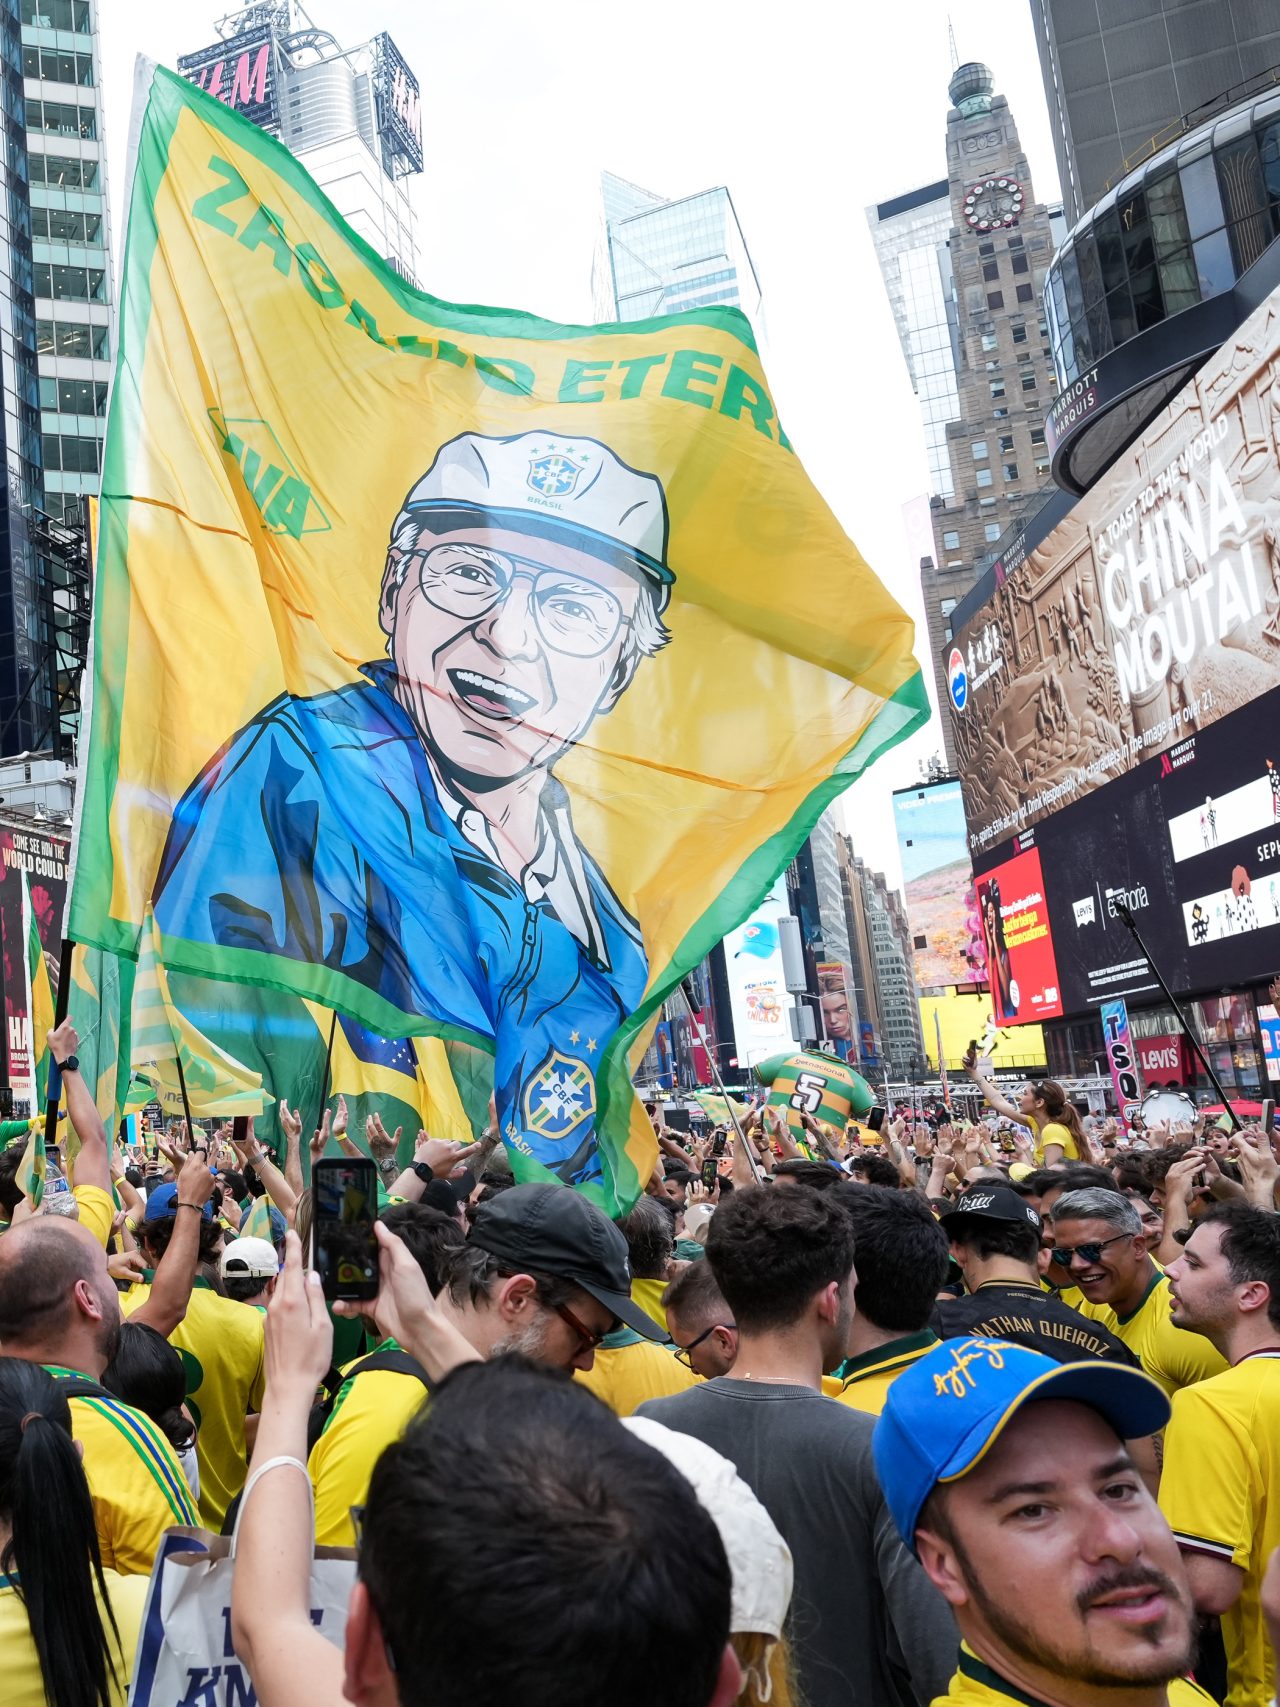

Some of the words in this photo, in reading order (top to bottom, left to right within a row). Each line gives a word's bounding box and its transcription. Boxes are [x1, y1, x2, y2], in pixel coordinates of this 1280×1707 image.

[557, 350, 794, 454] ETER
[1052, 368, 1099, 422] MARRIOTT
[1055, 392, 1095, 439] MARQUIS
[527, 496, 564, 511] BRASIL
[1099, 533, 1107, 552] A
[1107, 500, 1137, 544] TOAST
[1139, 486, 1155, 512] TO
[1156, 460, 1180, 498] THE
[1179, 414, 1228, 474] WORLD
[1003, 534, 1026, 563] MARRIOTT
[1005, 549, 1025, 575] MARQUIS
[1104, 457, 1247, 629] CHINA
[1114, 540, 1264, 704] MOUTAI
[1027, 793, 1042, 814] Drink
[1087, 749, 1120, 776] characters
[1129, 735, 1143, 755] the
[1143, 721, 1168, 747] image
[1168, 713, 1181, 731] are
[1182, 704, 1201, 723] over
[1170, 738, 1196, 758] MARRIOTT
[1172, 751, 1195, 769] MARQUIS
[2, 847, 34, 873] WORLD
[35, 856, 64, 881] COULD
[13, 833, 28, 849] COME
[30, 838, 39, 852] SEE
[41, 841, 53, 855] HOW
[54, 844, 65, 861] THE
[552, 1083, 573, 1106] CBF
[789, 1072, 829, 1113] 5
[969, 1316, 1035, 1339] NATHAN
[1039, 1320, 1111, 1357] QUEIROZ
